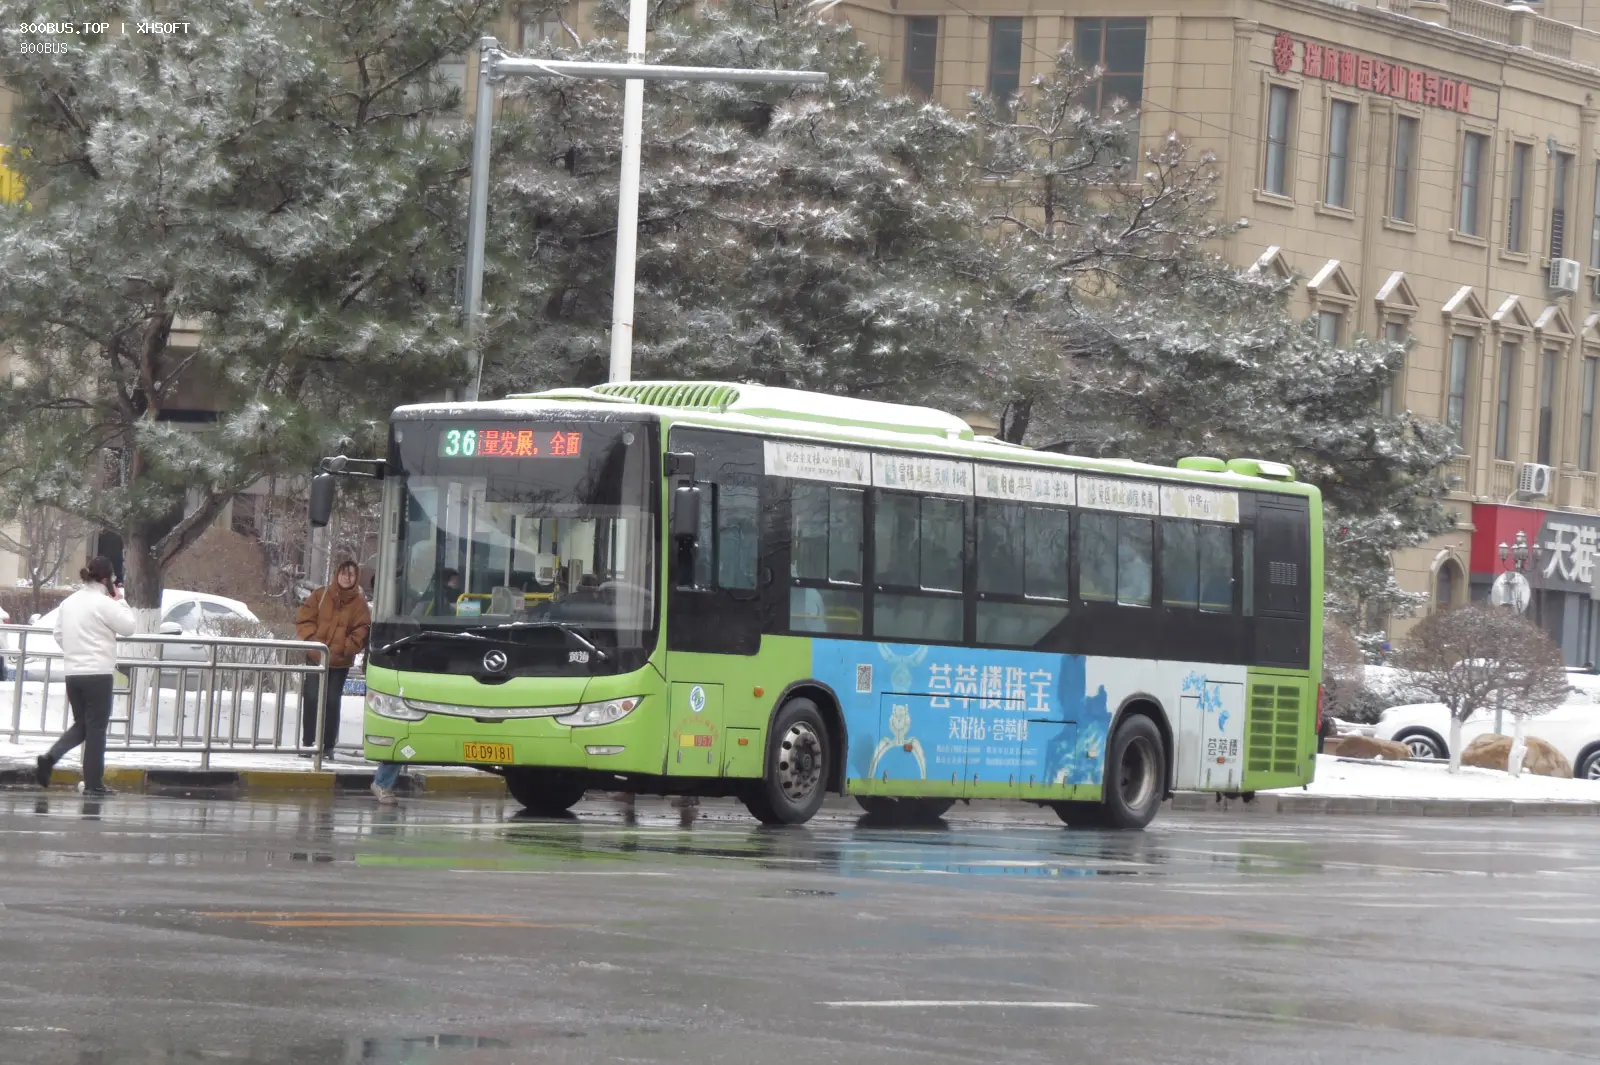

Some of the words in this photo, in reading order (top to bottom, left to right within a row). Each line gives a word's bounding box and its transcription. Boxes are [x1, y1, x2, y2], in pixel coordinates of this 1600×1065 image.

[445, 429, 477, 456] 36
[928, 663, 1053, 712] 荟萃楼珠宝
[1207, 737, 1238, 757] 荟萃楼
